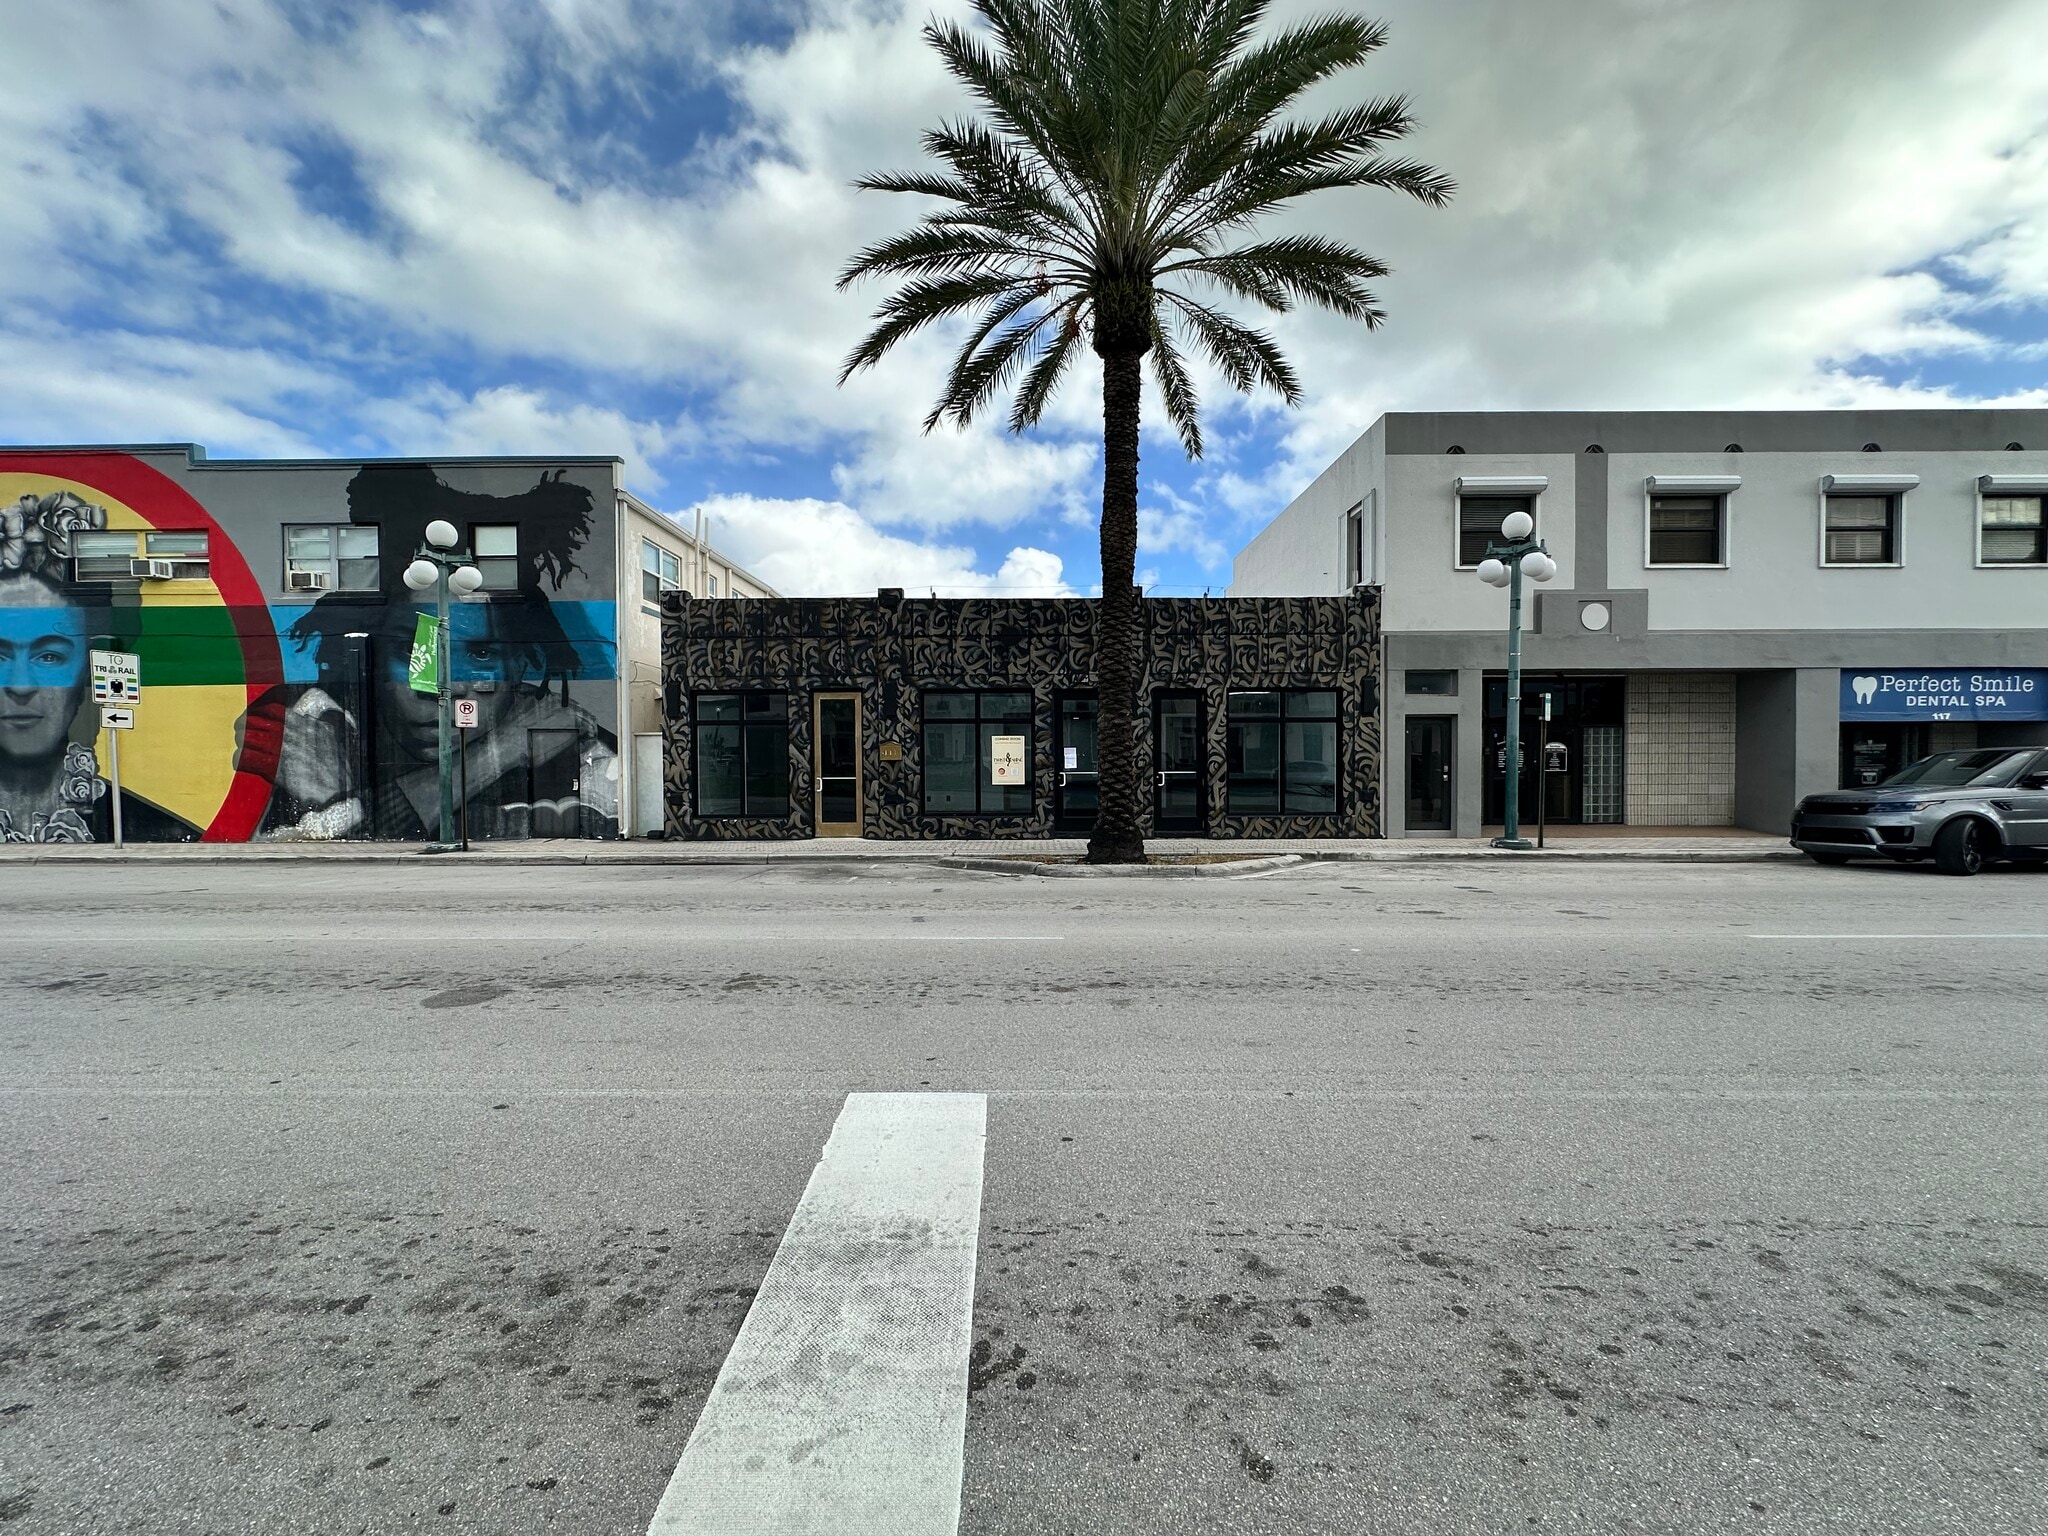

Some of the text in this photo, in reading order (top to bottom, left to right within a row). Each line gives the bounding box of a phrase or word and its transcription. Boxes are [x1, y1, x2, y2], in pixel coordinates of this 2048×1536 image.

[107, 654, 124, 665] TO
[94, 664, 137, 675] TRI RAIL
[1880, 675, 2034, 692] Perfect Smile
[1906, 695, 2006, 707] DENTAL SPA
[1932, 712, 1951, 720] 117
